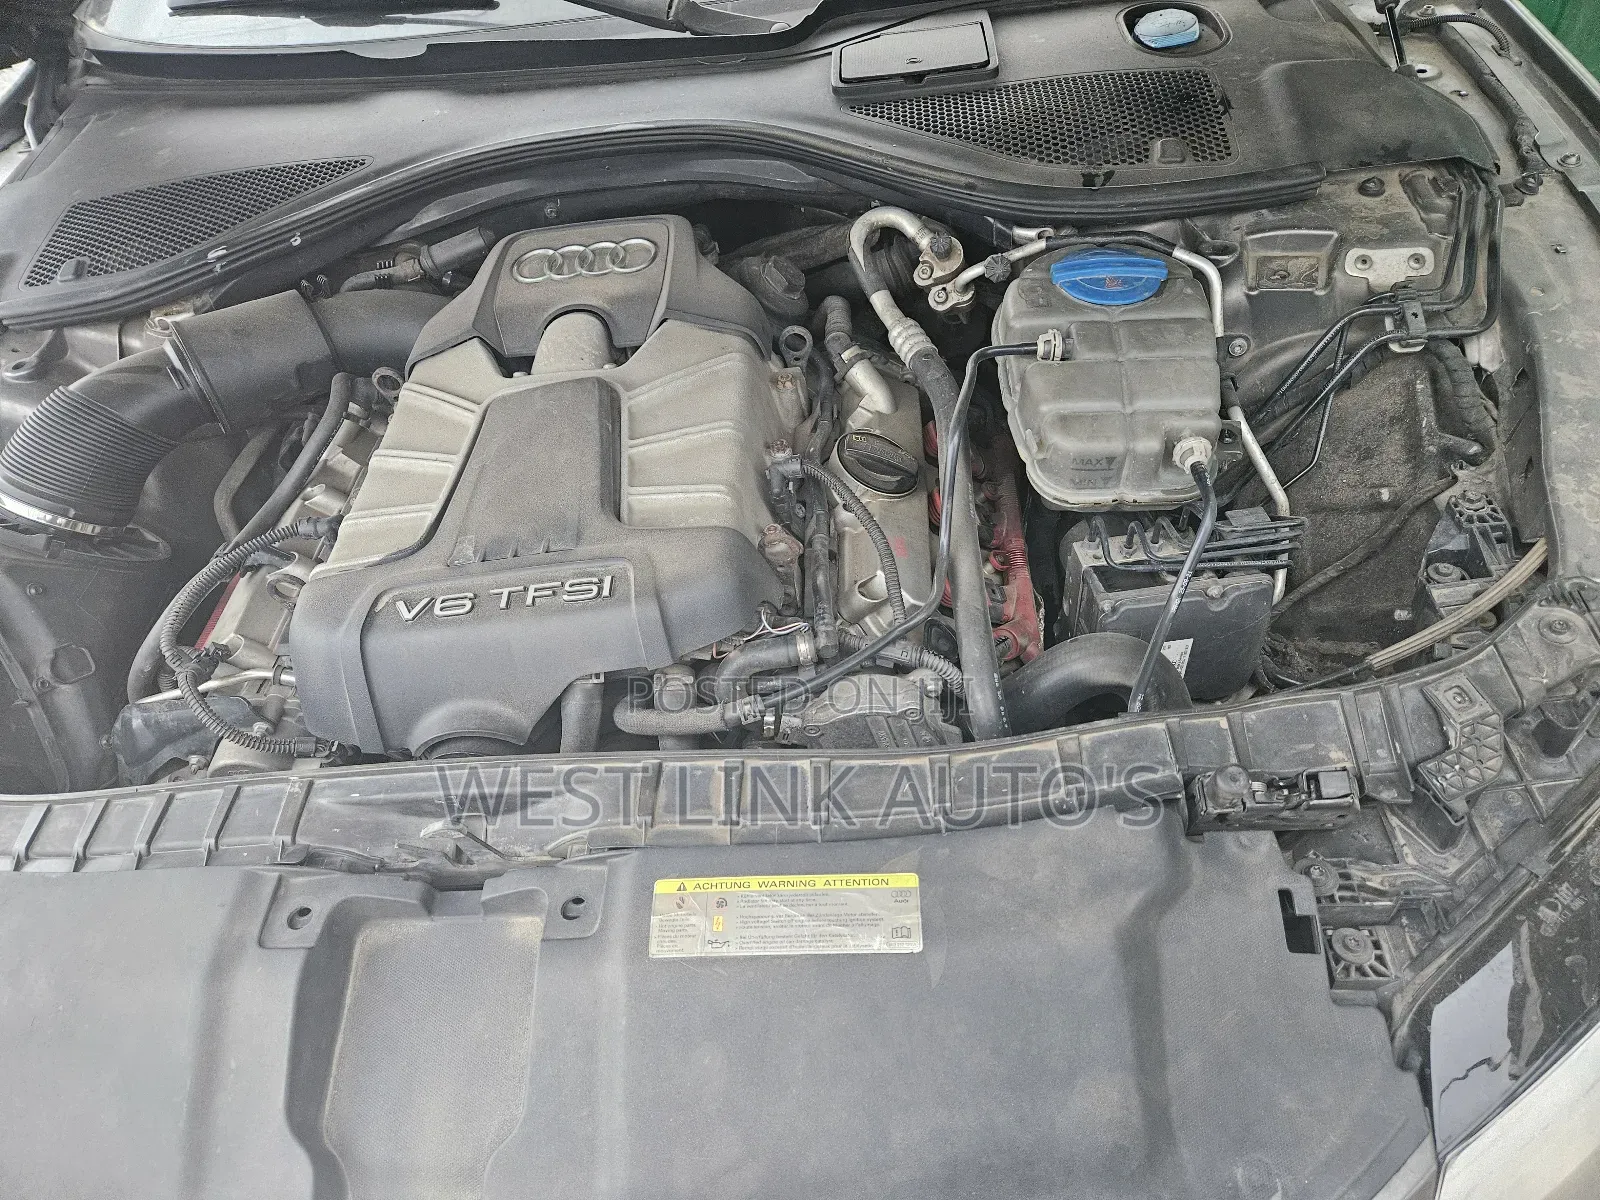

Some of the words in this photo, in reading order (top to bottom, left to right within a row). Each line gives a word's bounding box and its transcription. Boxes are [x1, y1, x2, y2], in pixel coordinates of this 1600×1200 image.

[1071, 457, 1104, 466] MAX
[395, 592, 478, 622] V6
[489, 575, 614, 611] TFSI
[693, 881, 751, 891] ACHTUNG
[757, 879, 817, 889] WARNING
[823, 877, 890, 888] ATTENTION
